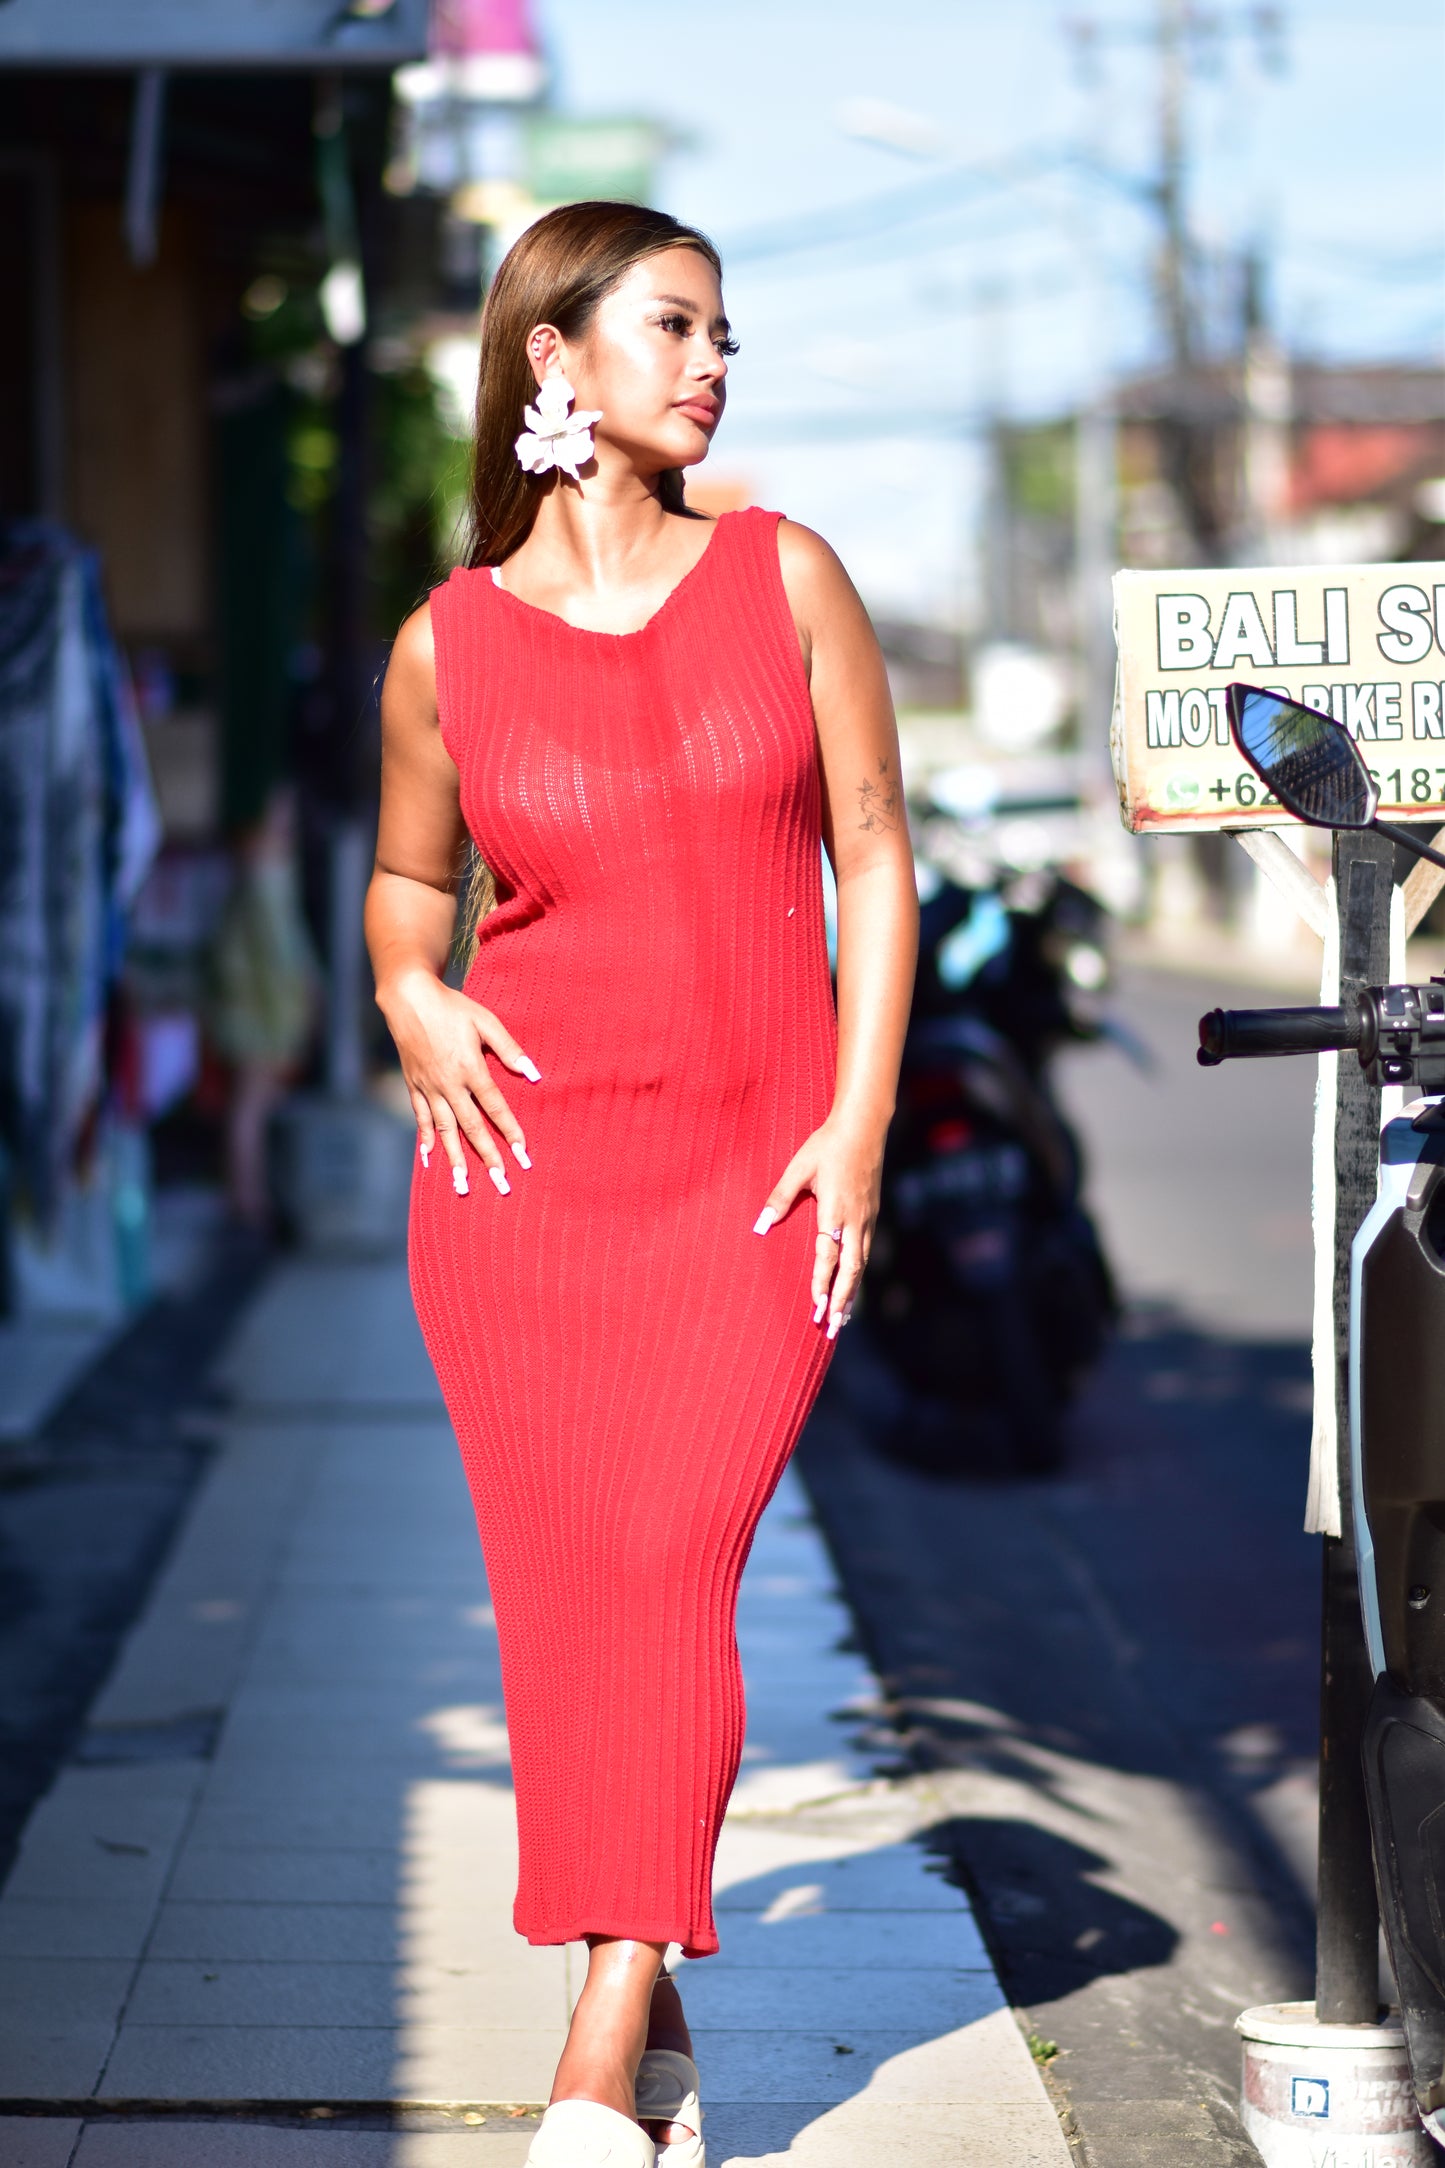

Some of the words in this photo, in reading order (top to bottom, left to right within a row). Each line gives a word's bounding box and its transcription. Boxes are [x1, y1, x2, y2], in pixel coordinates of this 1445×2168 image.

[1156, 587, 1350, 671] BALI
[1376, 584, 1445, 665] S
[1146, 685, 1292, 749] MOT
[1412, 681, 1445, 740] R
